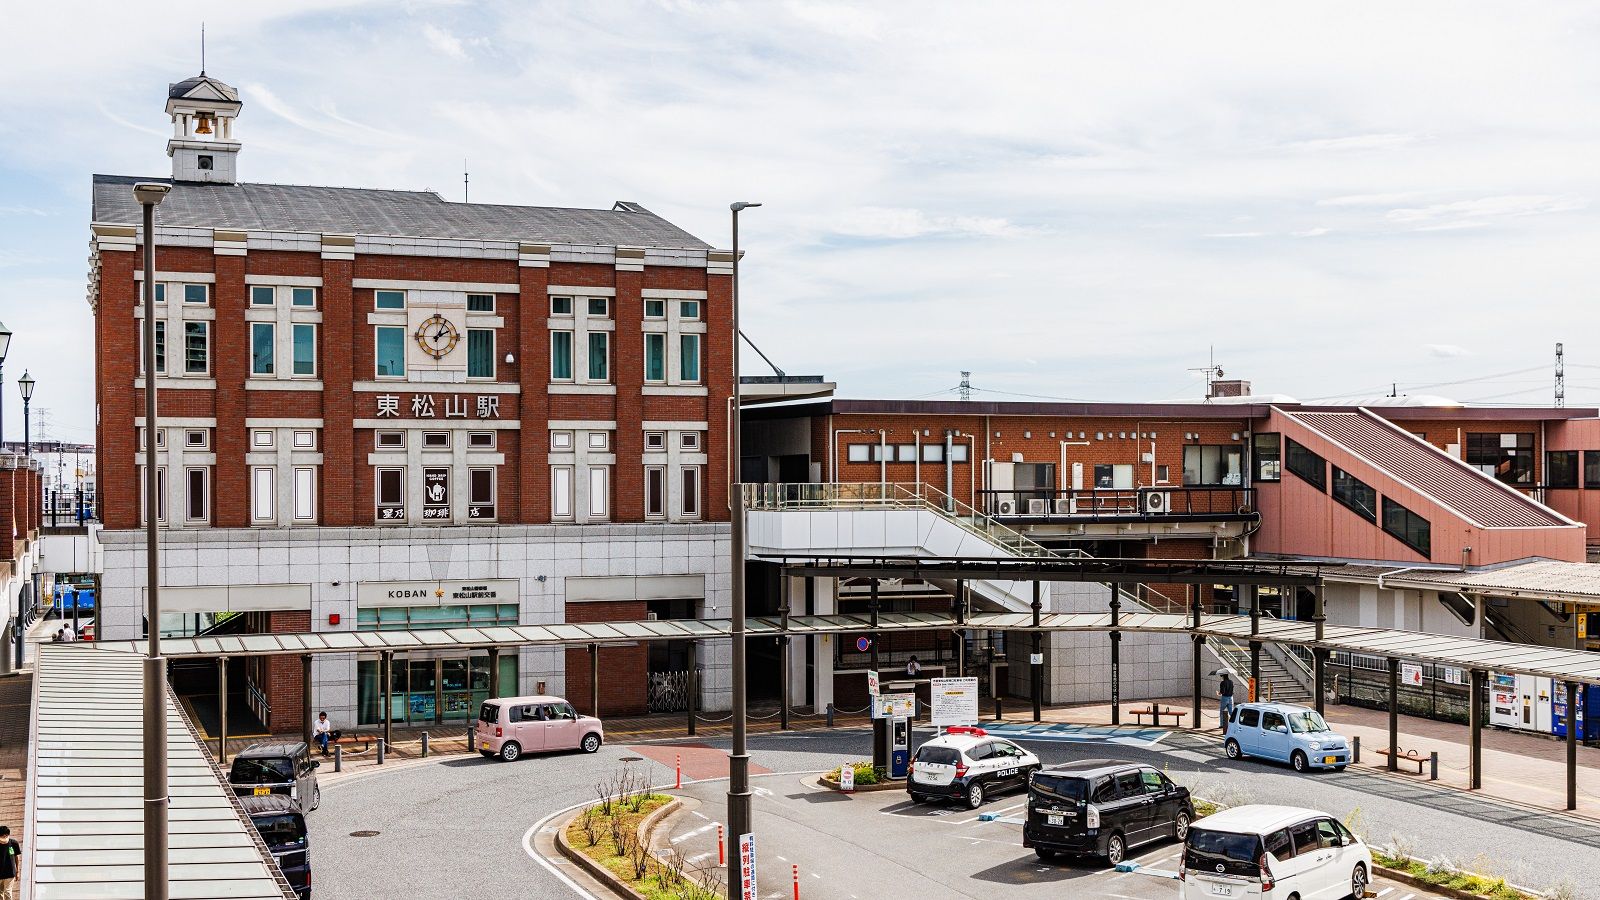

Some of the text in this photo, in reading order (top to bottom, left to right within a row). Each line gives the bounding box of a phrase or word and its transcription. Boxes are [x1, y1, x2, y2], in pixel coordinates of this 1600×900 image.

[376, 394, 499, 418] 東松山駅
[382, 507, 480, 519] 星乃 珈琲 店
[388, 590, 427, 598] KOBAN
[452, 591, 497, 599] 東松山駅前交番
[997, 768, 1019, 778] POLICE
